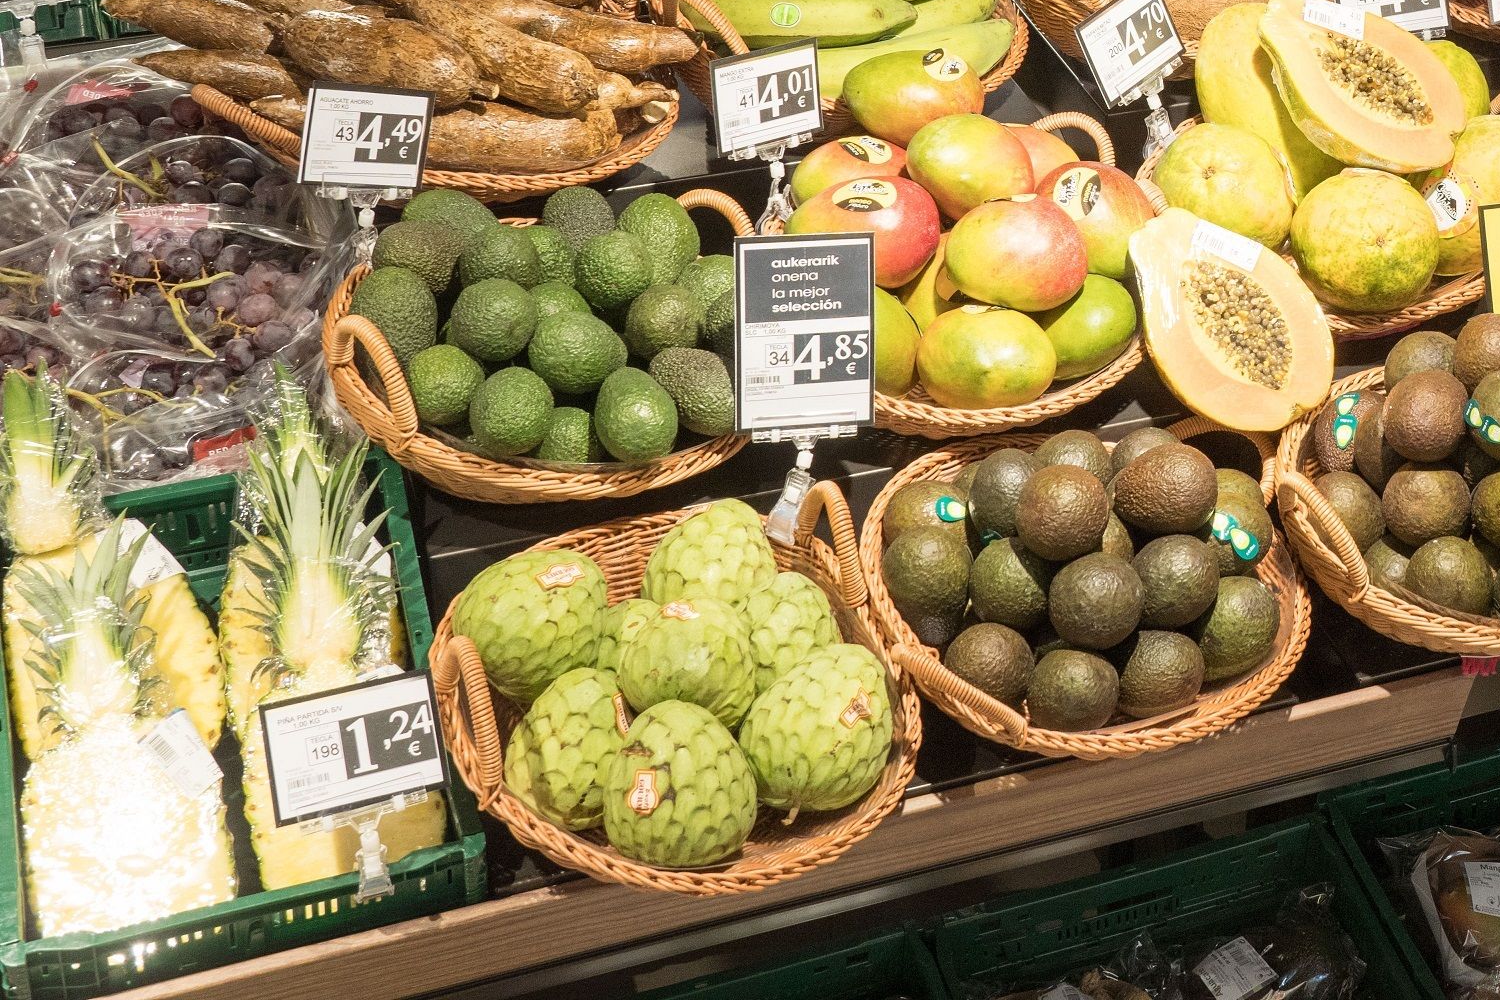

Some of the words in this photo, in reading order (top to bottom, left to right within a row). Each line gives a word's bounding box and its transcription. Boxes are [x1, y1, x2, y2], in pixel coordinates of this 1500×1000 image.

[1125, 1, 1166, 57] 4,70
[1155, 27, 1165, 39] €
[1108, 42, 1124, 59] 200
[758, 67, 813, 118] 4,01
[319, 96, 349, 105] AGUACATE
[350, 98, 374, 106] AHORRO
[740, 93, 755, 108] 41
[797, 95, 806, 108] €
[335, 127, 354, 141] 43
[355, 114, 423, 160] 4,49
[399, 146, 408, 158] €
[771, 255, 840, 269] aukerarik
[771, 271, 819, 283] onena
[771, 288, 786, 299] la
[789, 286, 831, 299] mejor
[771, 300, 843, 313] selección
[745, 322, 780, 330] CHIRIMOYA
[768, 351, 790, 366] 34
[793, 333, 869, 381] 4,85
[845, 361, 857, 375] €
[277, 715, 295, 726] PIÑA
[297, 709, 329, 721] PARTIDA
[309, 717, 321, 726] KG
[310, 734, 332, 744] TECLA
[345, 704, 433, 775] 1,24
[311, 743, 340, 760] 198
[408, 740, 422, 756] €
